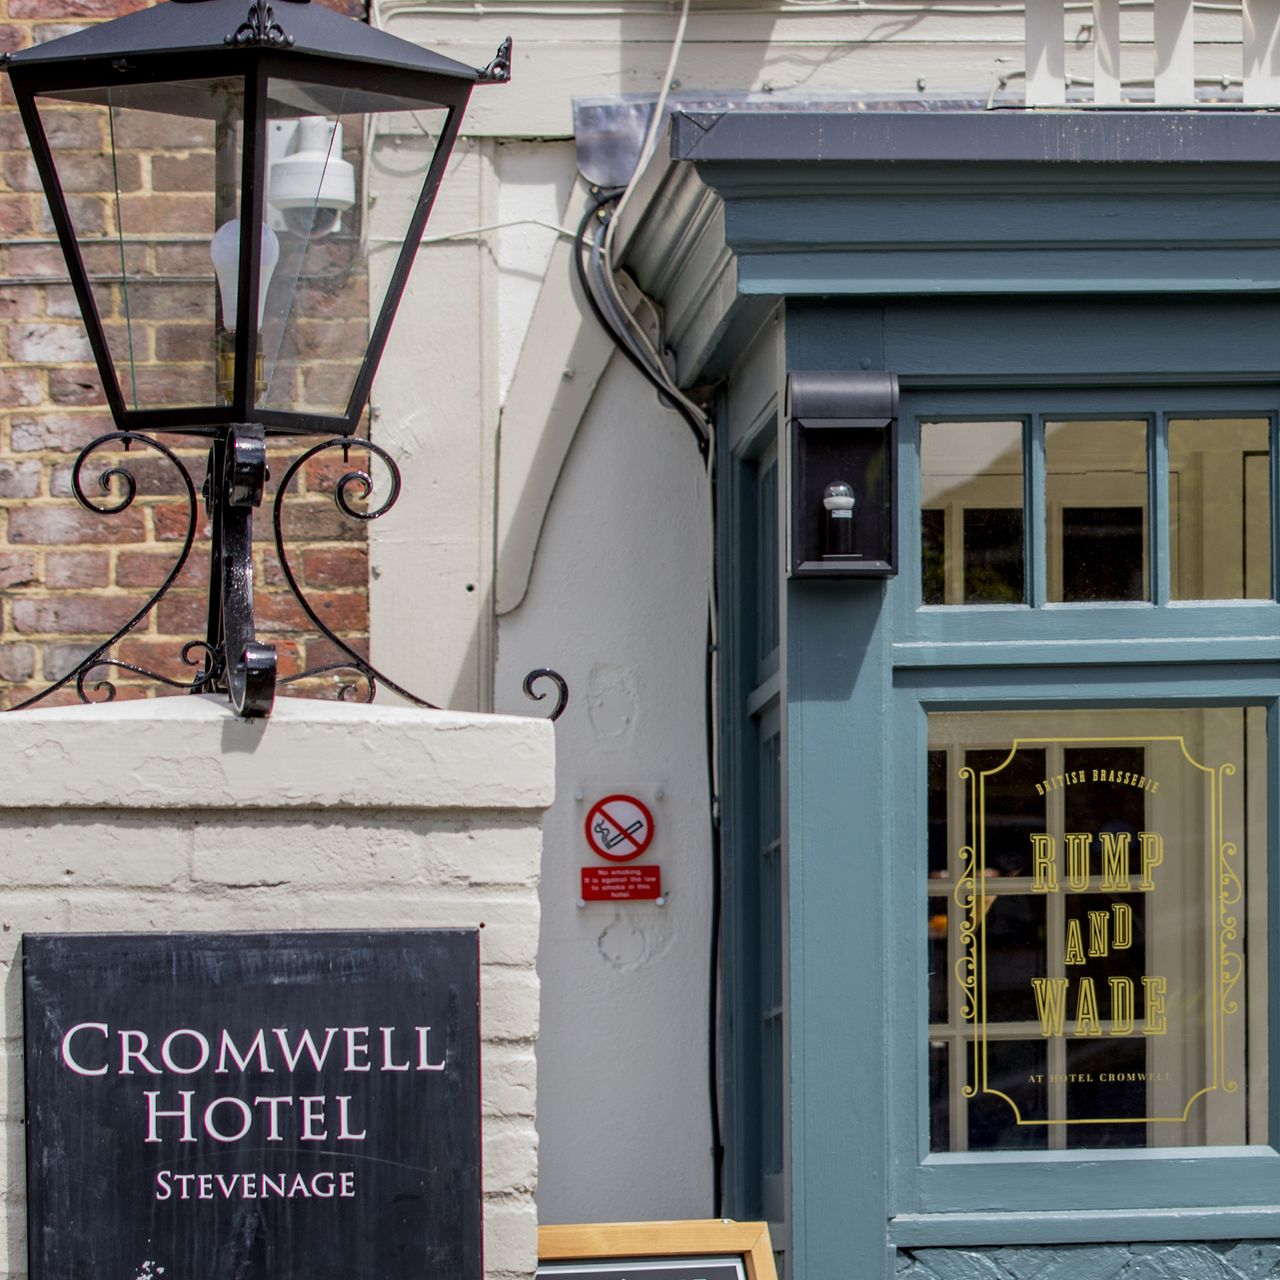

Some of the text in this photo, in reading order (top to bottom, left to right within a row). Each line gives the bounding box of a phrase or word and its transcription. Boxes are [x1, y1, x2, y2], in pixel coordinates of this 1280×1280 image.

[1035, 769, 1159, 796] BRITISH BRASSERIE
[1030, 832, 1163, 892] RUMP
[1064, 903, 1133, 965] AND
[1031, 976, 1168, 1037] WADE
[61, 1022, 446, 1077] CROMWELL
[1028, 1074, 1044, 1084] AT
[1050, 1073, 1094, 1083] HOTEL
[143, 1090, 367, 1144] HOTEL
[156, 1170, 355, 1201] STEVENAGE
